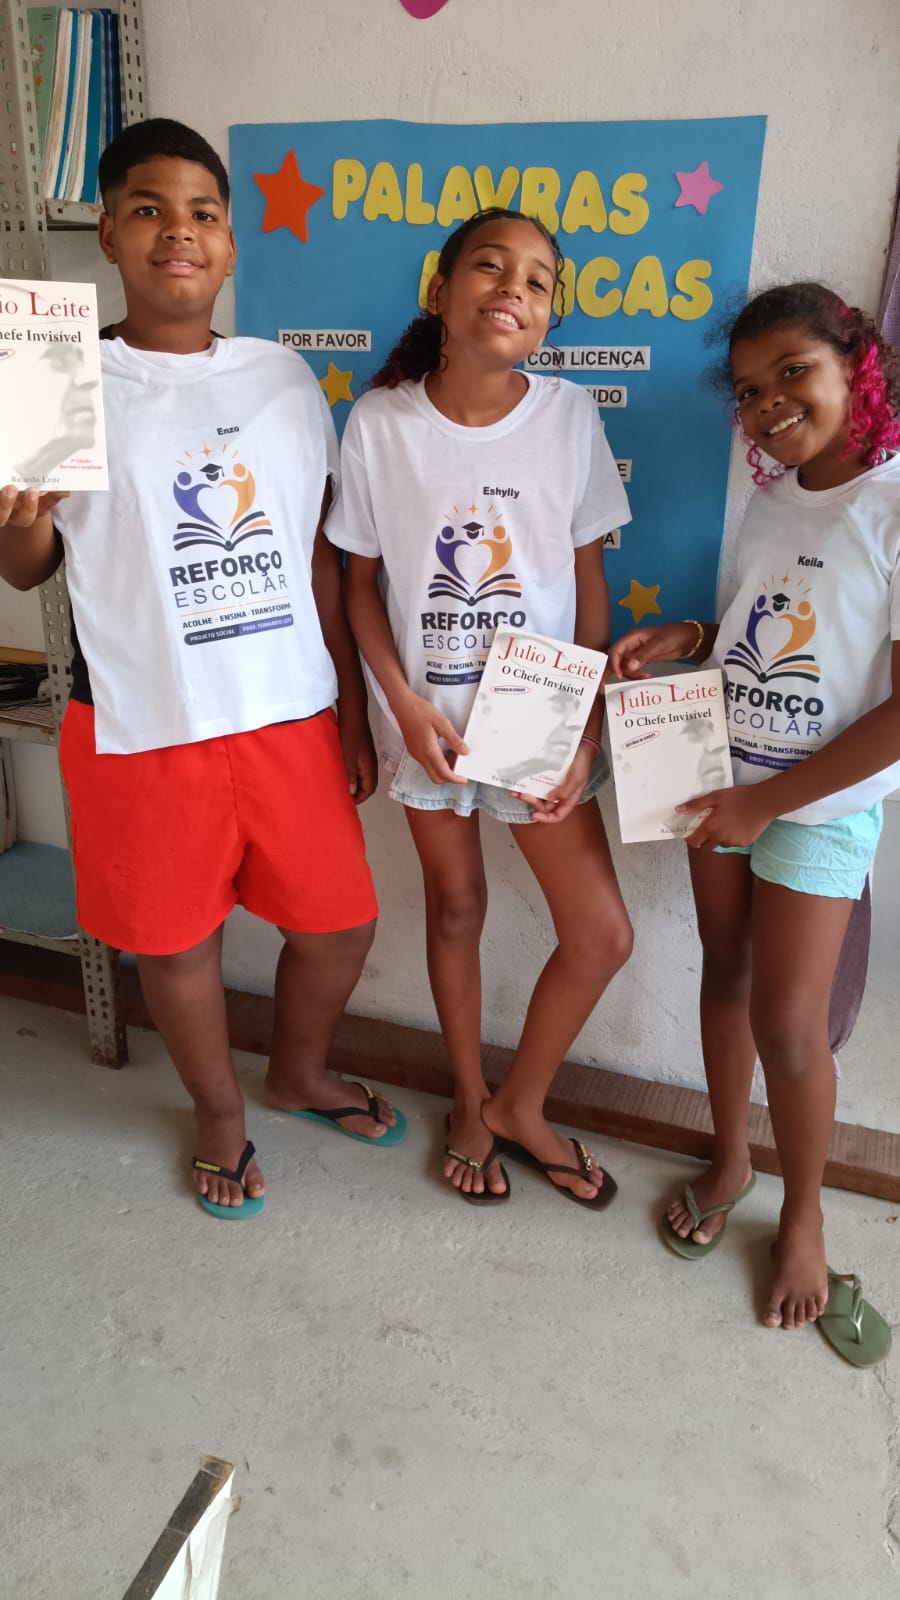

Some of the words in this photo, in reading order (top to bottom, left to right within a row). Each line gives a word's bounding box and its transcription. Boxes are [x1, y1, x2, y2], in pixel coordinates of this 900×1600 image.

[332, 158, 649, 235] PALAVRAS
[28, 291, 90, 318] Leite
[27, 329, 82, 343] Invisível
[282, 333, 312, 347] POR
[316, 333, 367, 348] FAVOR
[527, 351, 565, 366] COM
[570, 351, 645, 369] LICENÇA
[216, 424, 240, 436] Enzo
[482, 486, 520, 499] Eshylly
[169, 550, 283, 587] REFORÇO
[797, 555, 824, 569] Keila
[174, 573, 288, 608] ESCOLAR
[182, 617, 213, 629] ACOLHE
[219, 611, 247, 622] ENSINA
[250, 602, 292, 616] TRANSFORMA
[422, 634, 492, 651] ESCOL
[448, 661, 474, 670] ENSINA
[498, 636, 546, 666] Julio
[552, 650, 599, 680] Leite
[502, 665, 511, 675] O
[513, 668, 542, 684] Chefe
[615, 690, 662, 717] Julio
[668, 683, 718, 703] Leite
[726, 681, 824, 718] EFORÇO
[624, 718, 634, 729] O
[636, 715, 666, 728] Chefe
[726, 703, 822, 737] COLAR
[734, 736, 758, 749] ENSINA
[763, 744, 817, 756] TRANSFORM
